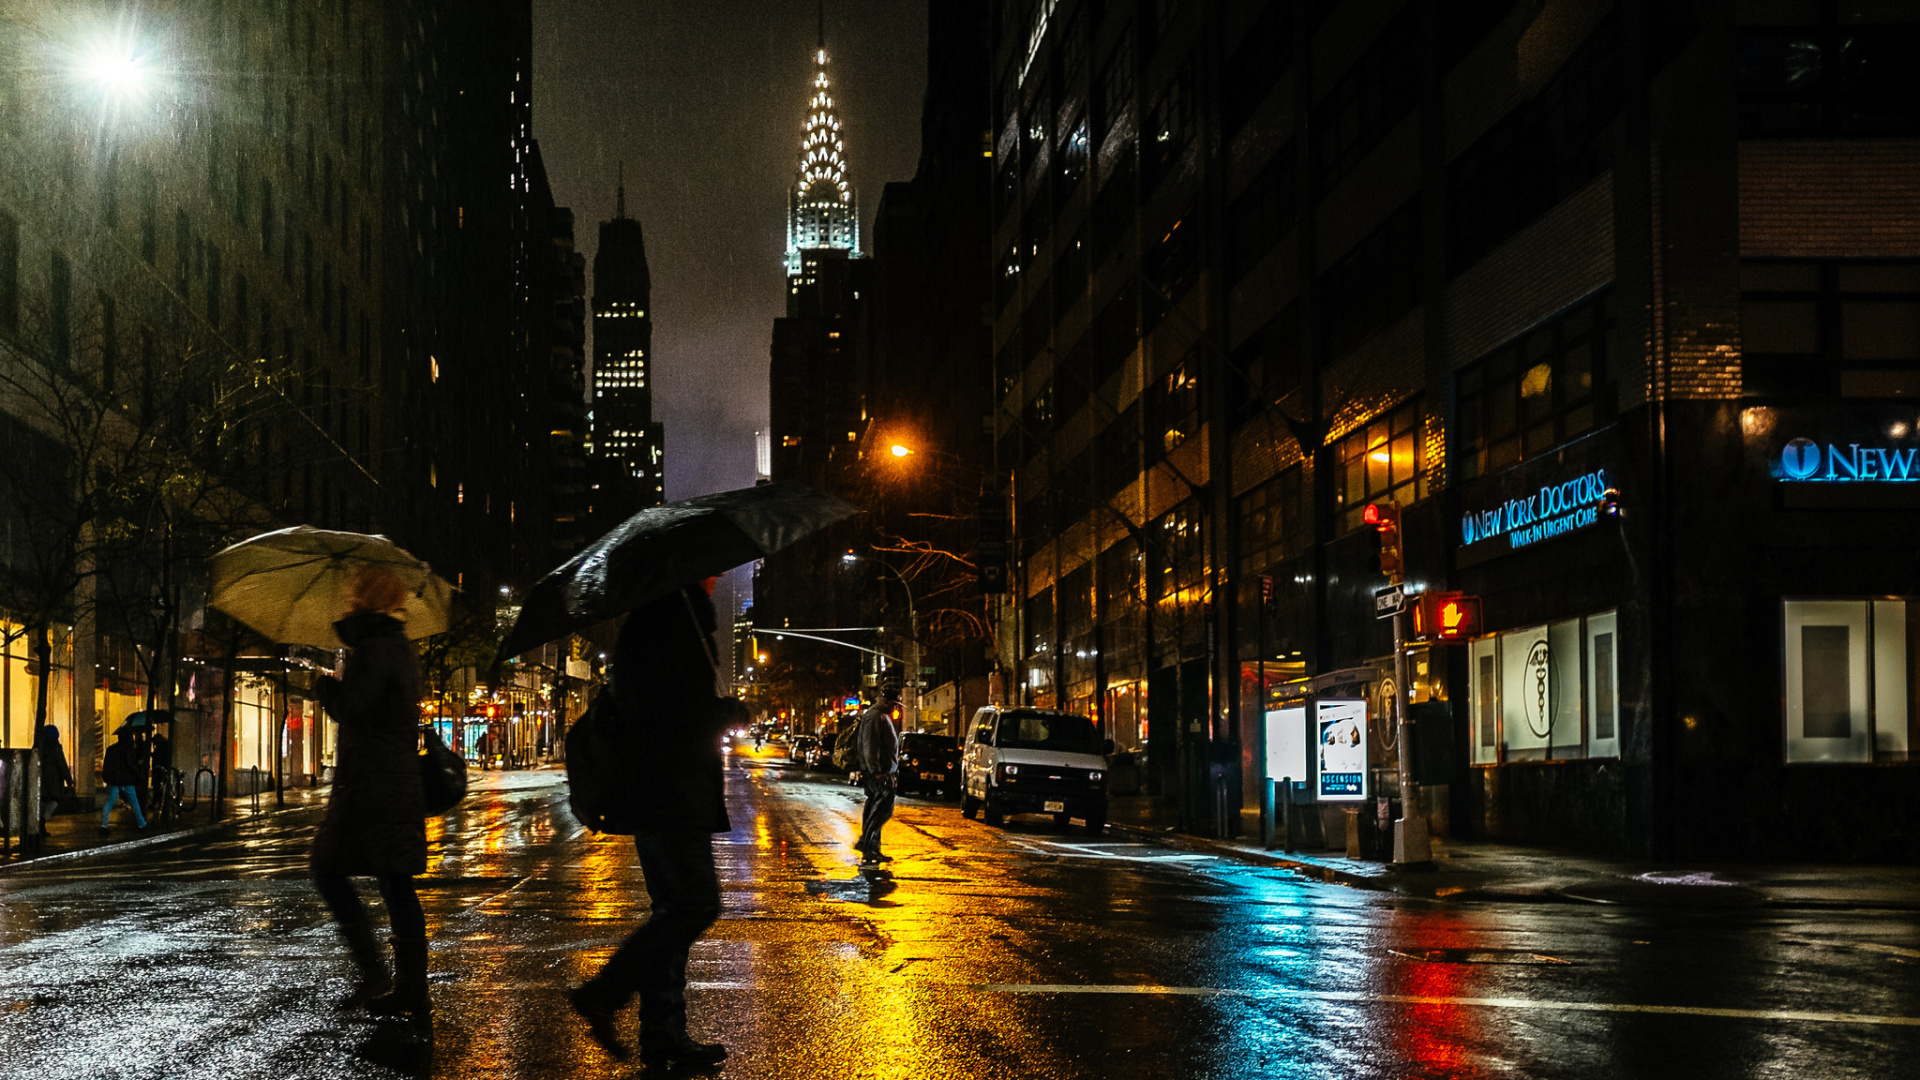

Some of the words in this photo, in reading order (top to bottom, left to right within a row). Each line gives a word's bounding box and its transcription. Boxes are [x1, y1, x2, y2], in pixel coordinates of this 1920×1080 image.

[1826, 443, 1918, 479] NEW
[1475, 507, 1503, 542] NEW
[1503, 495, 1538, 532] YORK
[1540, 468, 1606, 519] DOCTORS
[1510, 523, 1543, 548] WALK-IN
[1543, 514, 1575, 539] URGENT
[1575, 506, 1598, 528] CARE
[1322, 775, 1361, 783] ASCENSION
